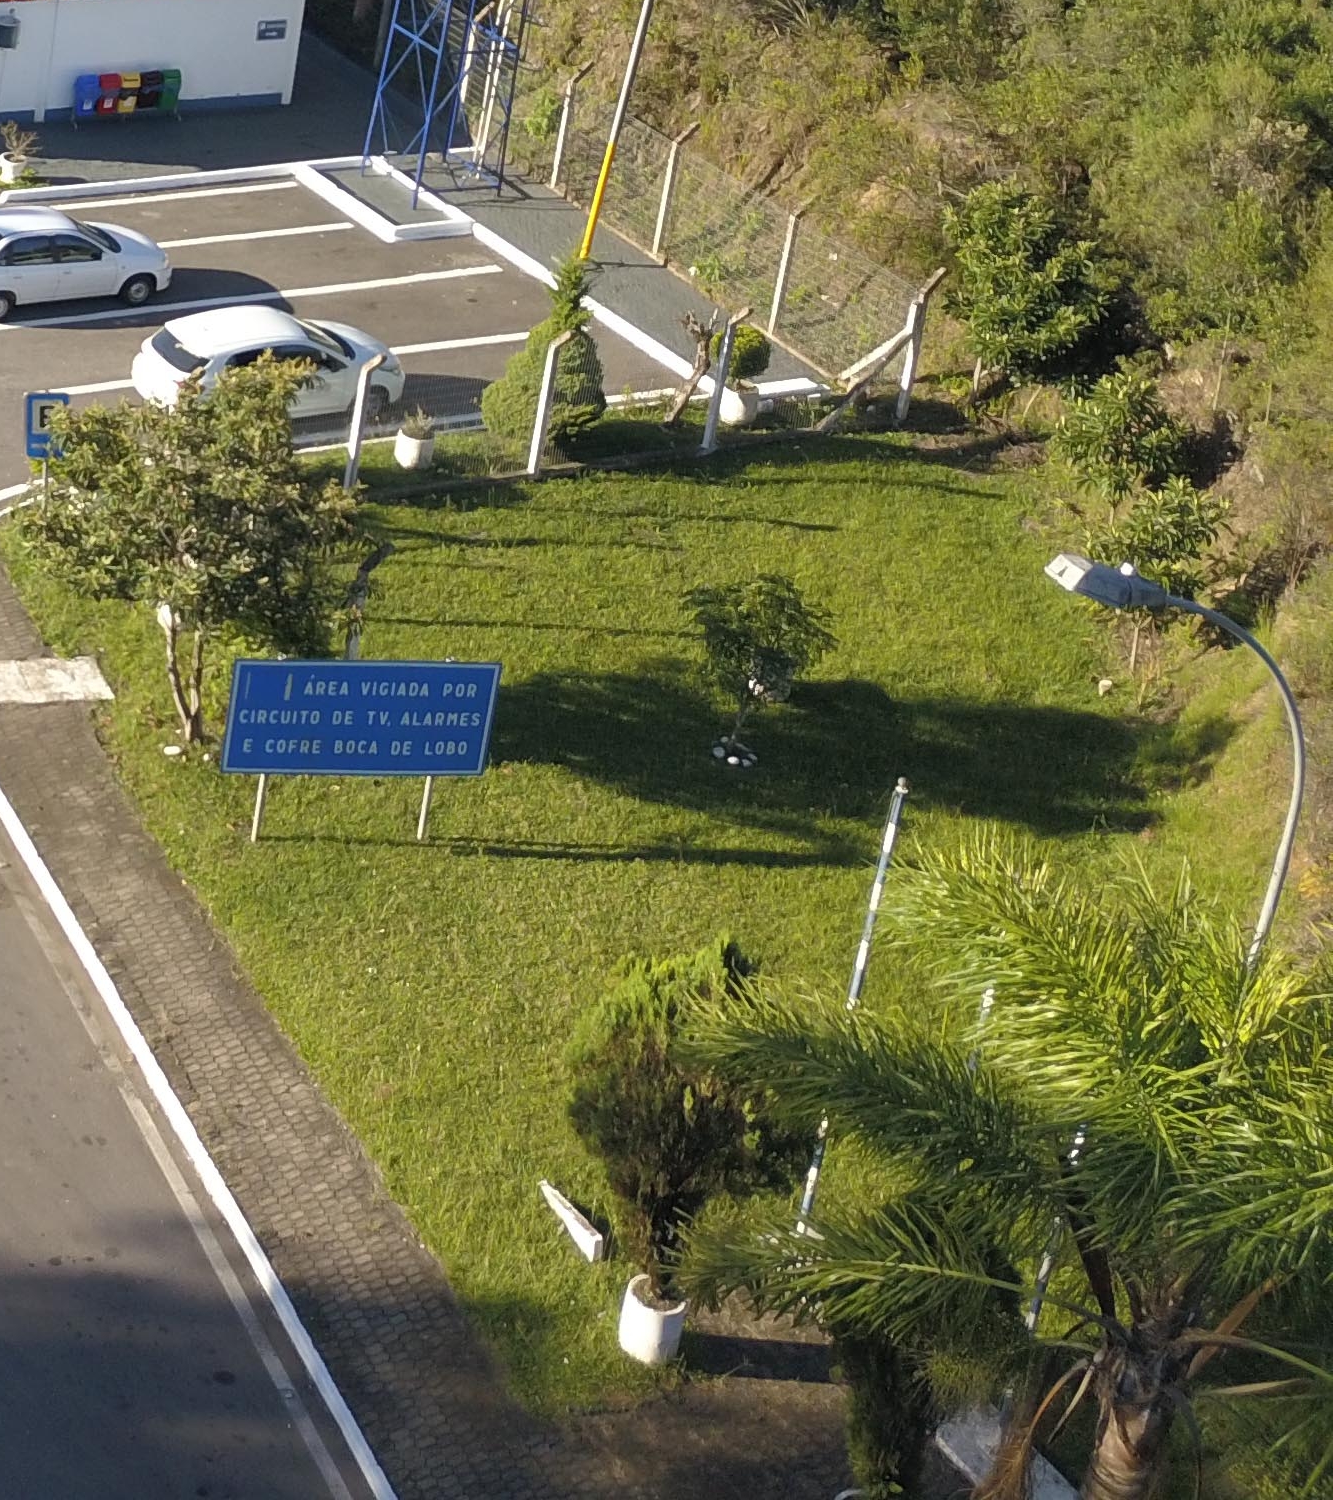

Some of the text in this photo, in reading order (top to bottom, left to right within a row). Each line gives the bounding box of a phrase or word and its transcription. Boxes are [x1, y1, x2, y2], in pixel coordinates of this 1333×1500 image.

[303, 674, 478, 698] ÁREA VIGIADA POR
[238, 709, 321, 725] CIRCUITO
[331, 710, 354, 725] DE
[399, 711, 481, 727] ALARMES
[242, 738, 469, 756] E COFRE BOCA DE LOBO
